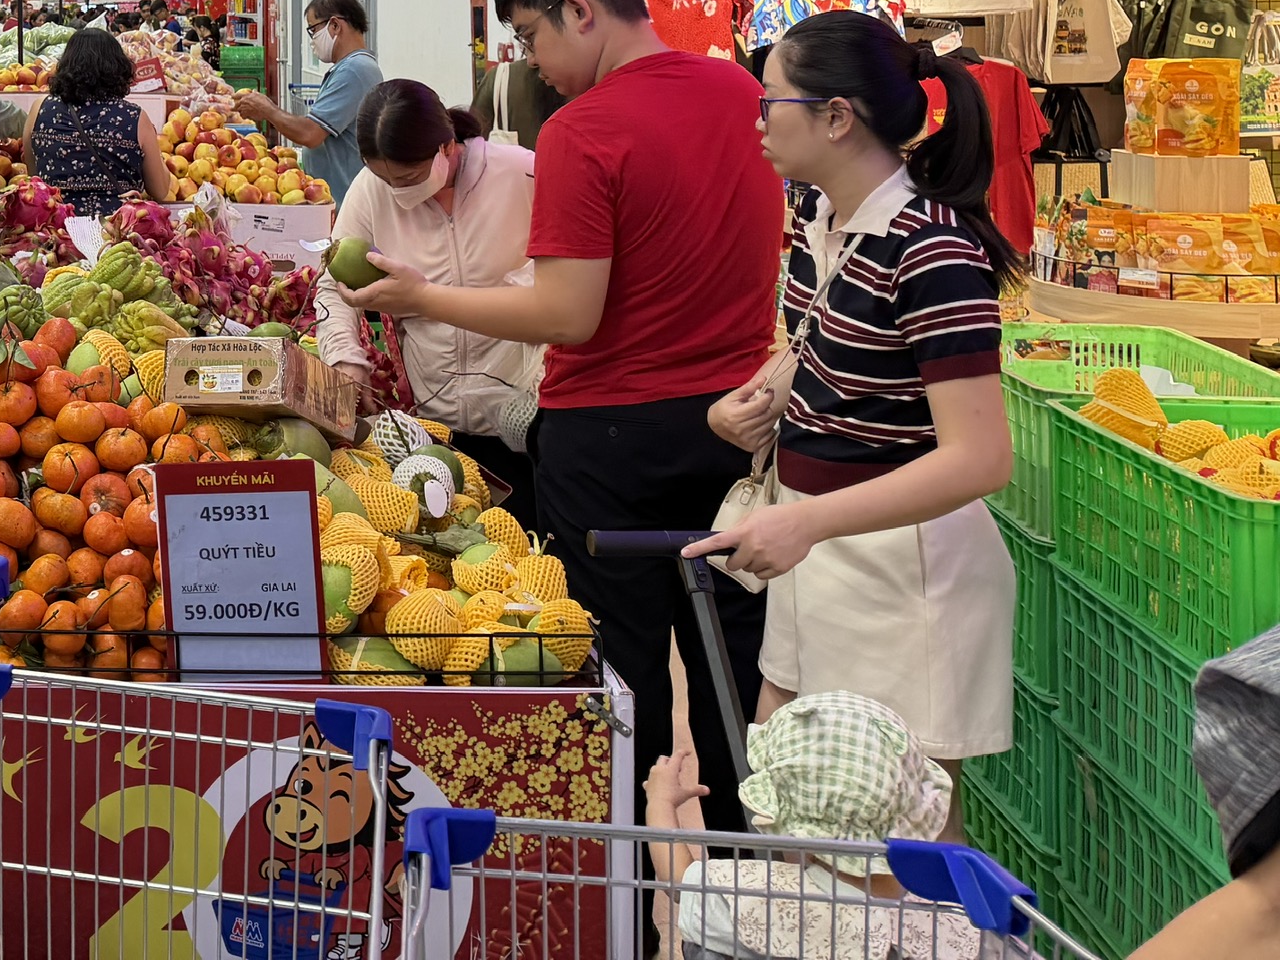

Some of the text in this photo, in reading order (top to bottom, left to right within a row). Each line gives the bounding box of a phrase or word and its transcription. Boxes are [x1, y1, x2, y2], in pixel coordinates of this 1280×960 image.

[191, 342, 262, 354] Hợp Tác Xã Hòa Lộc
[173, 358, 188, 367] Trái
[196, 470, 275, 487] KHUYẾN MÃI
[199, 504, 270, 522] 459331
[199, 542, 276, 561] QUÝT TIỀU
[181, 582, 297, 594] XUẤT XỨ: GIA LAI
[184, 601, 300, 621] 59.000Đ/KG
